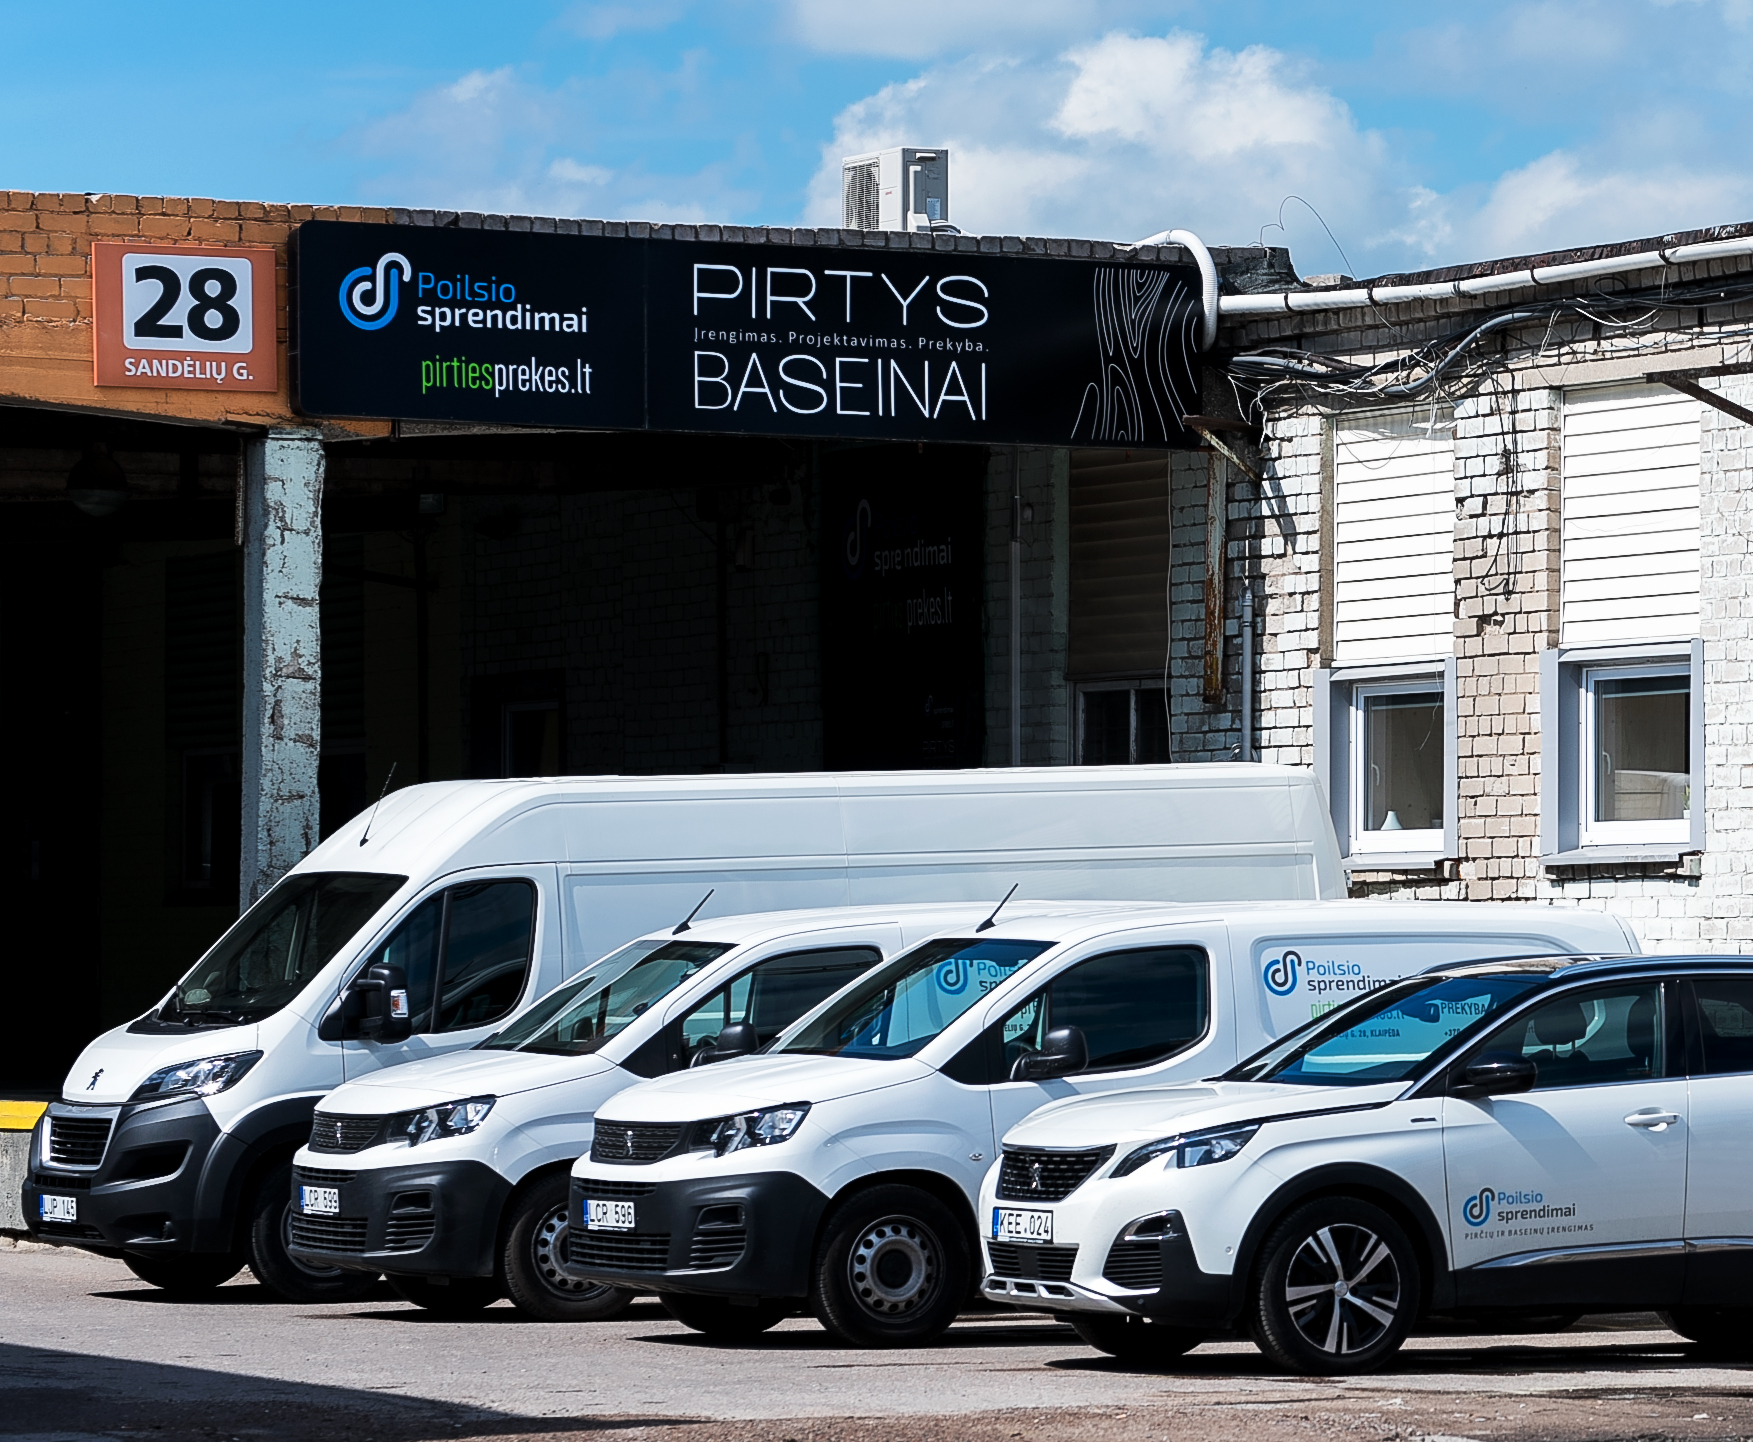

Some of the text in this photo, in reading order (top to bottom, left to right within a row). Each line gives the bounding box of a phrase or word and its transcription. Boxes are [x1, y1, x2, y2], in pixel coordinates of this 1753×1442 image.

[418, 272, 516, 303] Poilsio
[693, 263, 989, 328] PIRTYS
[133, 264, 241, 342] 28
[416, 303, 588, 333] sprendimai
[694, 327, 990, 353] Įrengimas. Projektavimas. Prekyba.
[124, 356, 254, 383] SANDĖLIŲ G.
[421, 355, 593, 398] pirtiesprekes.lt
[694, 350, 987, 421] BASEINAI
[1305, 960, 1362, 977] Poilsio
[1497, 1190, 1543, 1205] Poilsio
[589, 1202, 633, 1225] LCR 596
[1497, 1203, 1576, 1224] sprendimai
[1496, 1229, 1505, 1238] IR
